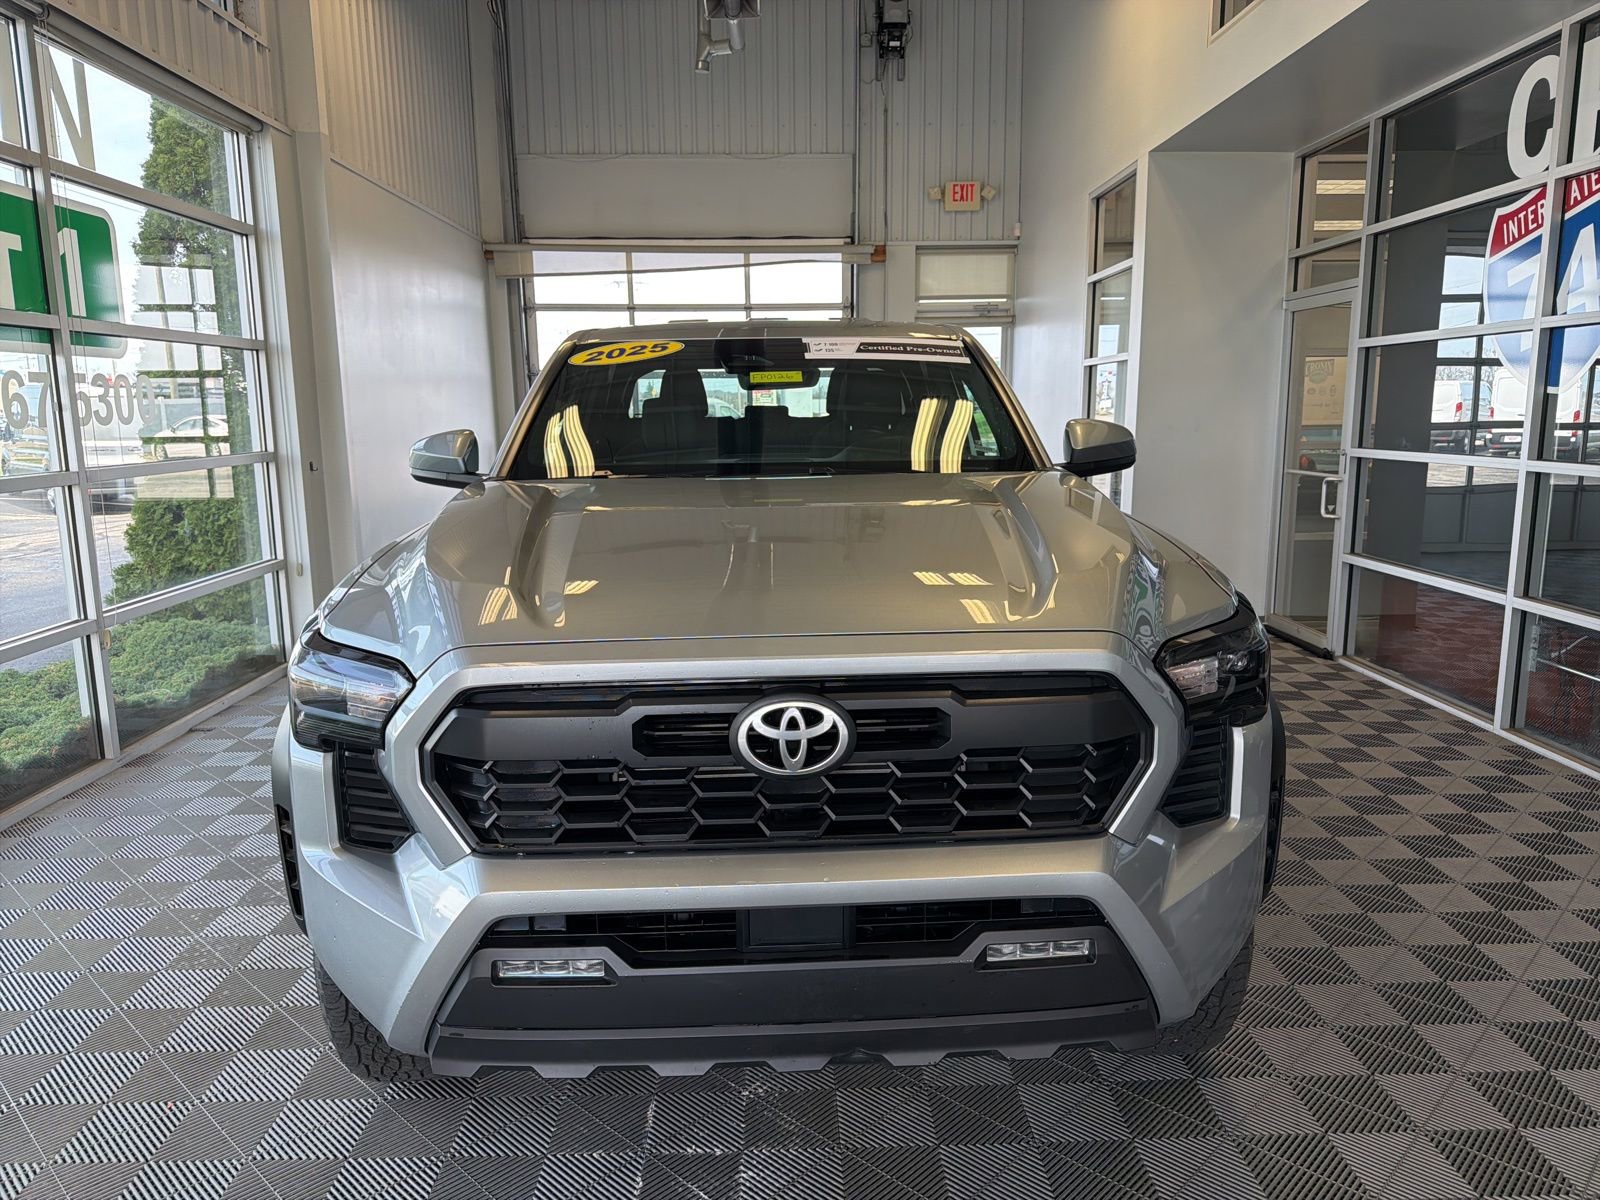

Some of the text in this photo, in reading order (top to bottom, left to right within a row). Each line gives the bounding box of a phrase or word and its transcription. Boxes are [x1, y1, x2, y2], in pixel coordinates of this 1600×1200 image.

[952, 183, 975, 202] EXIT
[1503, 172, 1600, 246] INTERATE
[57, 227, 87, 317] 1
[1507, 222, 1600, 352] 74
[582, 342, 670, 364] 2025
[859, 344, 904, 352] Certified
[906, 346, 961, 354] Pre-Owned
